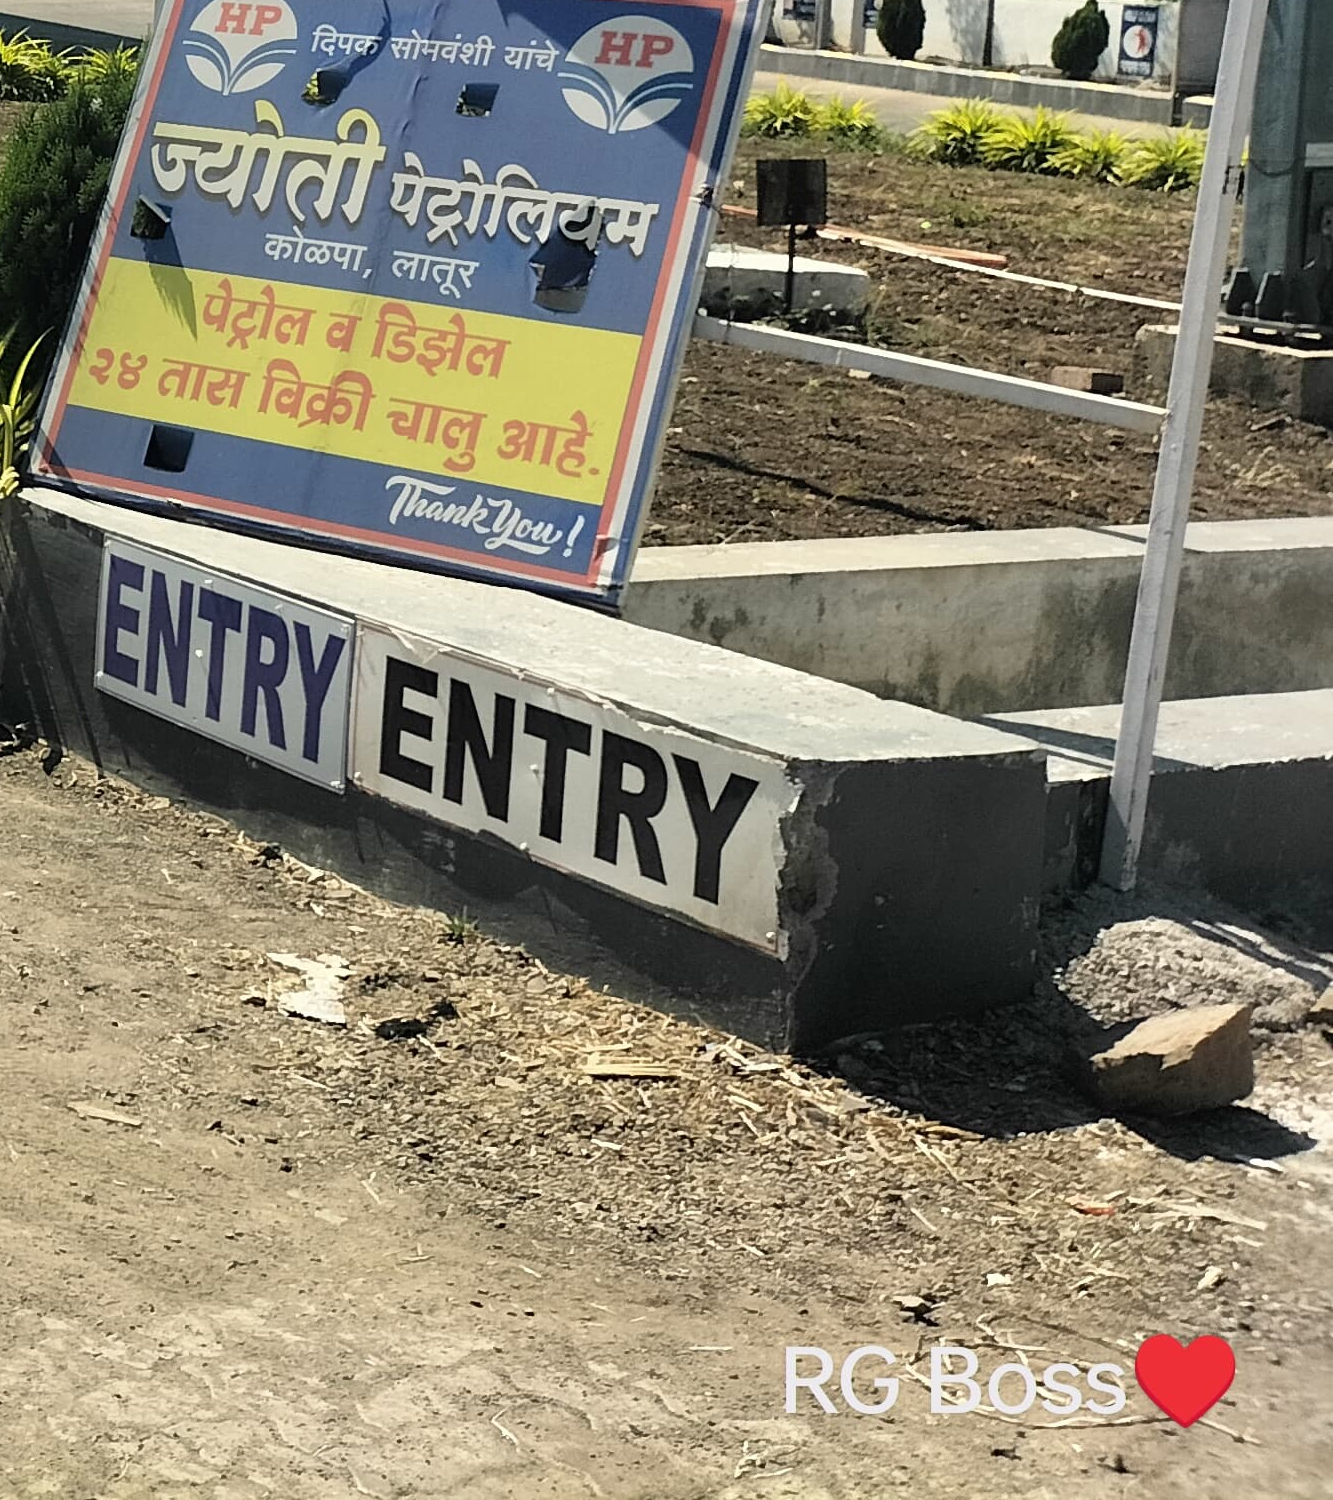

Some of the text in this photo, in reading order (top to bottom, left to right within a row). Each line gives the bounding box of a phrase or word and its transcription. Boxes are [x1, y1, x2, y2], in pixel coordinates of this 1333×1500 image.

[214, 1, 283, 37] HP
[311, 23, 560, 73] दिपक सोमवंशी यांचे
[593, 30, 675, 69] HP
[151, 99, 660, 257] ज्योती पेट्रोलियम
[264, 225, 481, 299] कोळपा, लातूर
[202, 277, 512, 380] पेट्रोल व डिझेल
[88, 347, 600, 478] २४ तास विक्री चालु आहे.
[101, 553, 346, 763] ENTRY
[379, 656, 760, 906] ENTRY
